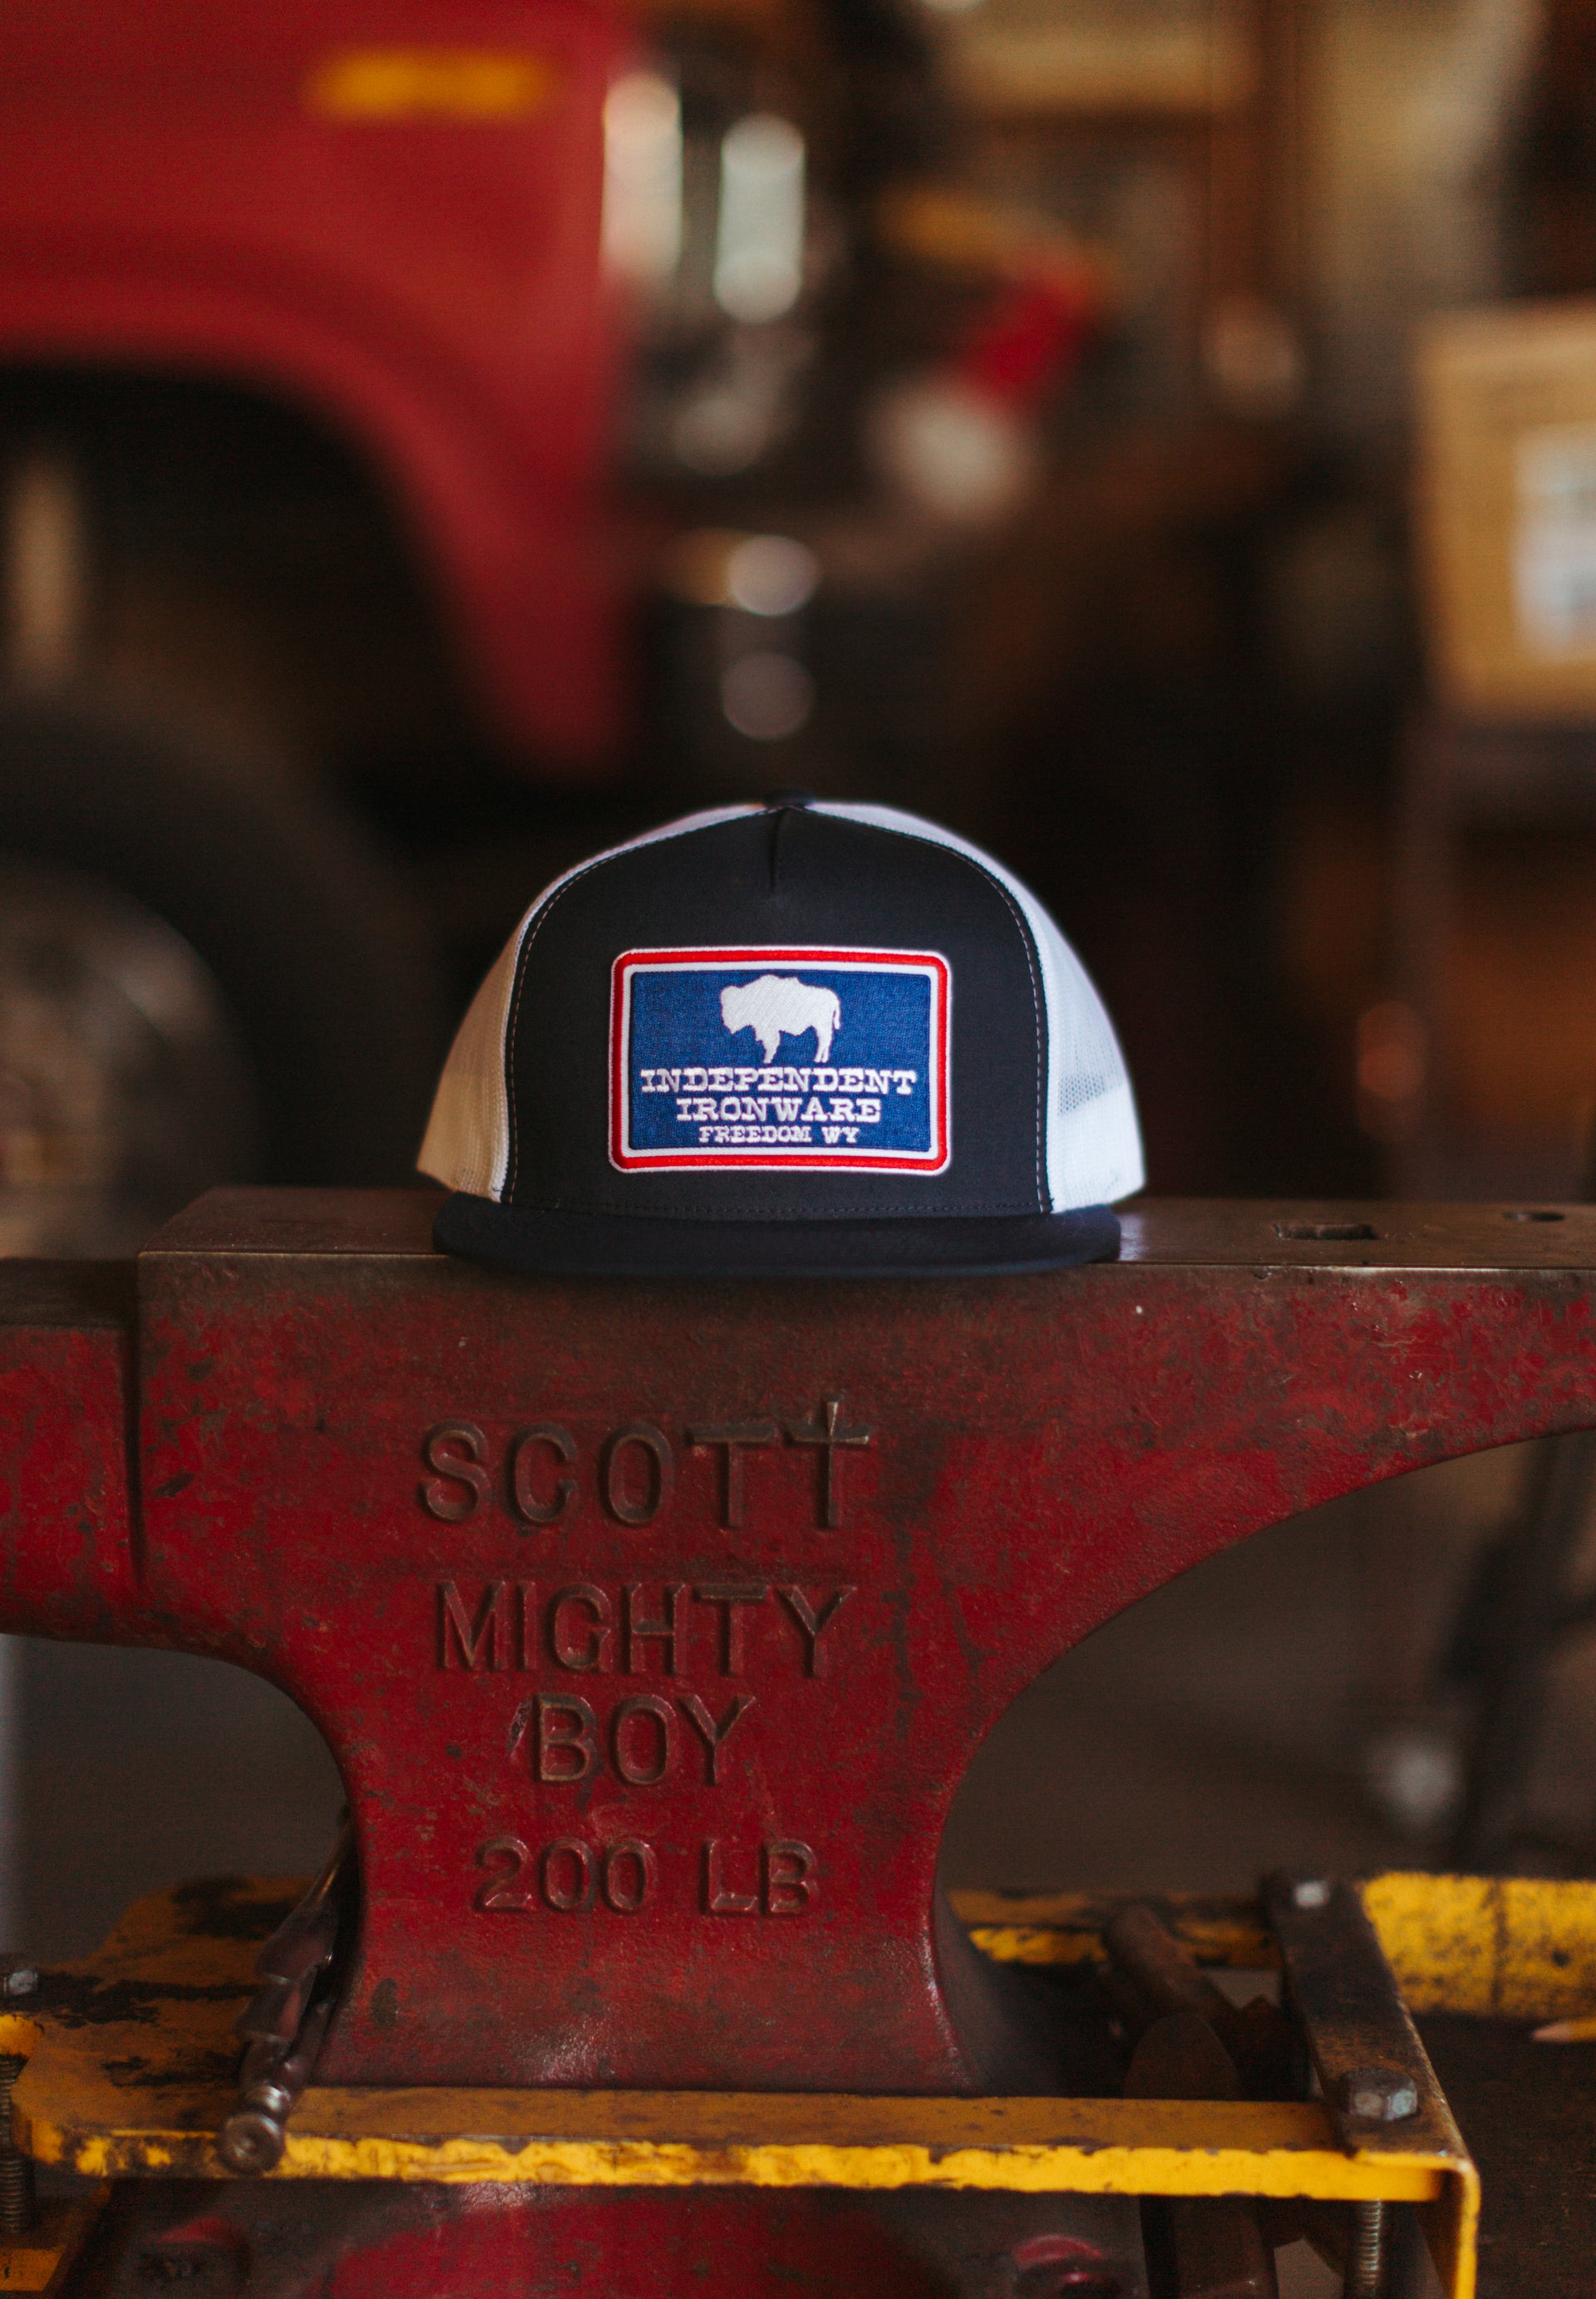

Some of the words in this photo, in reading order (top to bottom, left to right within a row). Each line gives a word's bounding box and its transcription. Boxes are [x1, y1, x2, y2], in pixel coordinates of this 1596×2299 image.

[640, 1066, 917, 1095] INDEPENDENT
[676, 1096, 881, 1123] IRONWARE
[698, 1125, 811, 1145] FREEDOM
[821, 1125, 860, 1145] WY
[420, 1406, 874, 1531] SCOTT
[436, 1581, 859, 1678] MIGHTY
[531, 1692, 757, 1786] BOY
[474, 1836, 658, 1914] 200
[701, 1838, 820, 1916] LB
